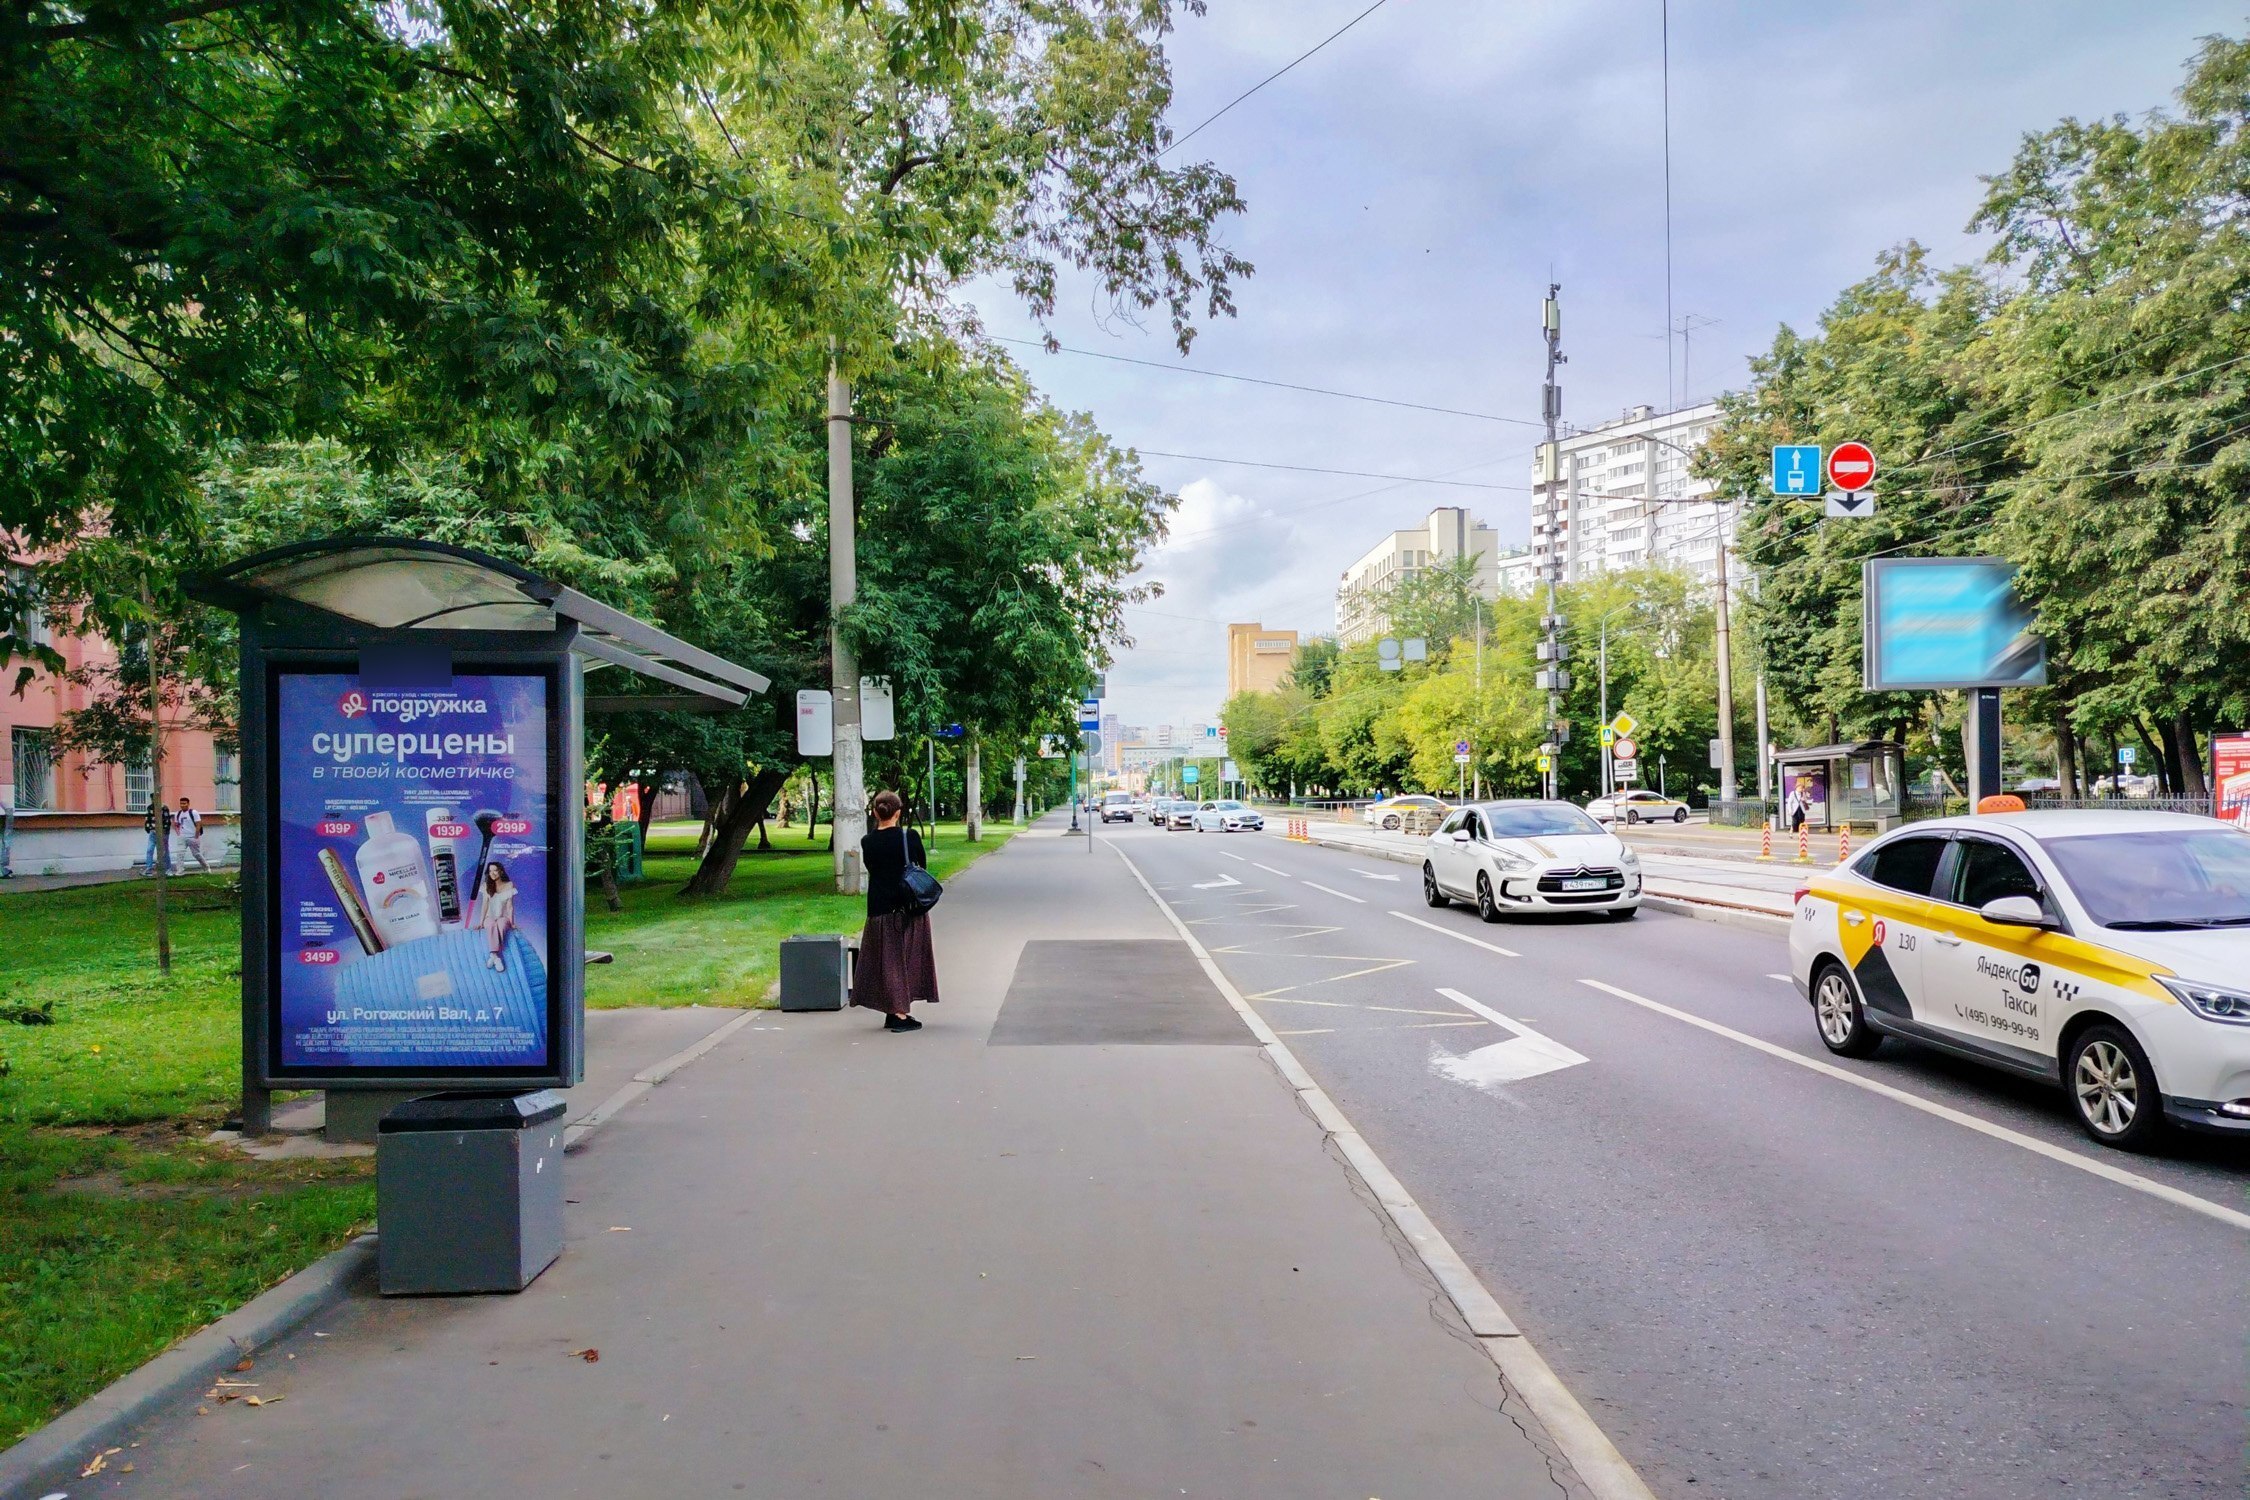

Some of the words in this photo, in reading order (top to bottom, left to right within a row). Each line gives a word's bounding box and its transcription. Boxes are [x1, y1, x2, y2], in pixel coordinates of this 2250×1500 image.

[372, 699, 487, 722] подружка
[312, 732, 515, 762] суперцены
[313, 767, 324, 779] в
[333, 762, 389, 779] твоей
[396, 766, 515, 779] косметичке
[1874, 922, 1884, 942] Я
[1898, 933, 1916, 951] 130
[1976, 955, 2019, 983] Яндекс
[2020, 968, 2038, 989] Go
[327, 1010, 349, 1024] ул.
[353, 1006, 435, 1020] Рогожский
[439, 1007, 472, 1022] Вал,
[475, 1009, 490, 1022] д.
[493, 1007, 503, 1020] 7
[2001, 989, 2038, 1018] Такси
[1964, 1006, 1989, 1027] (495)
[1990, 1016, 2040, 1041] 999-99-99
